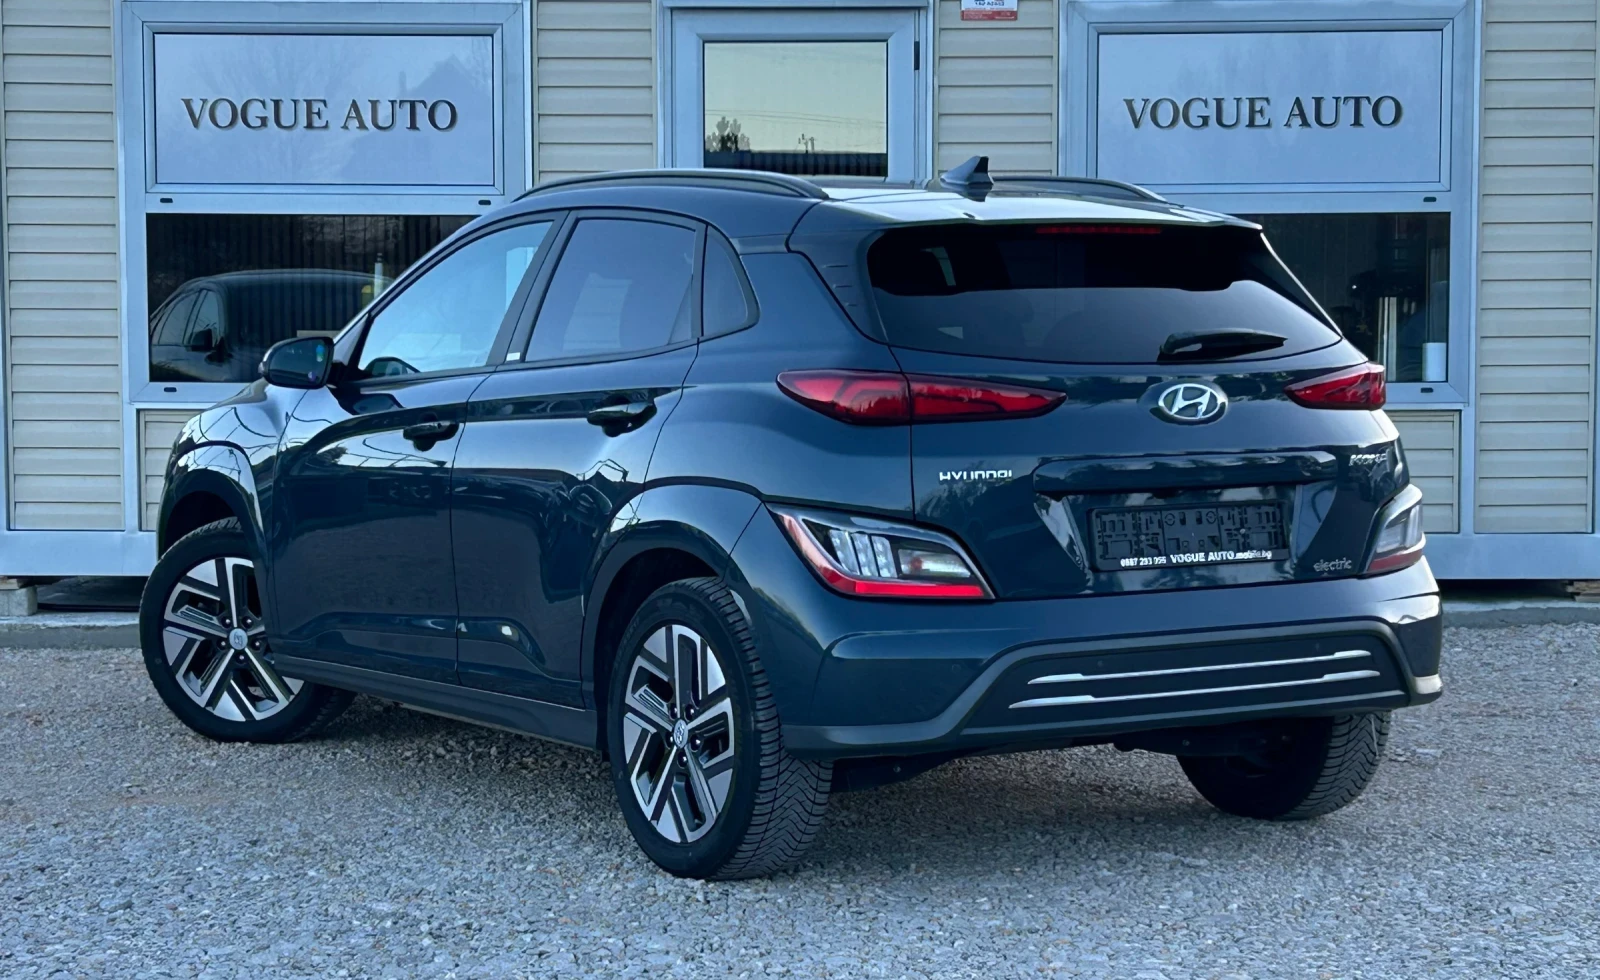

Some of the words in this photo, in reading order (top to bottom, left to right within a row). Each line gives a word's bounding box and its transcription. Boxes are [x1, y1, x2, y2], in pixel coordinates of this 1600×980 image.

[181, 98, 329, 130] VOGUE
[340, 99, 458, 131] AUTO
[1123, 97, 1272, 128] VOGUE
[1284, 96, 1403, 128] AUTO
[939, 469, 1012, 481] HYUNDAI
[1170, 552, 1205, 564] VOGUE
[1313, 557, 1352, 573] electric
